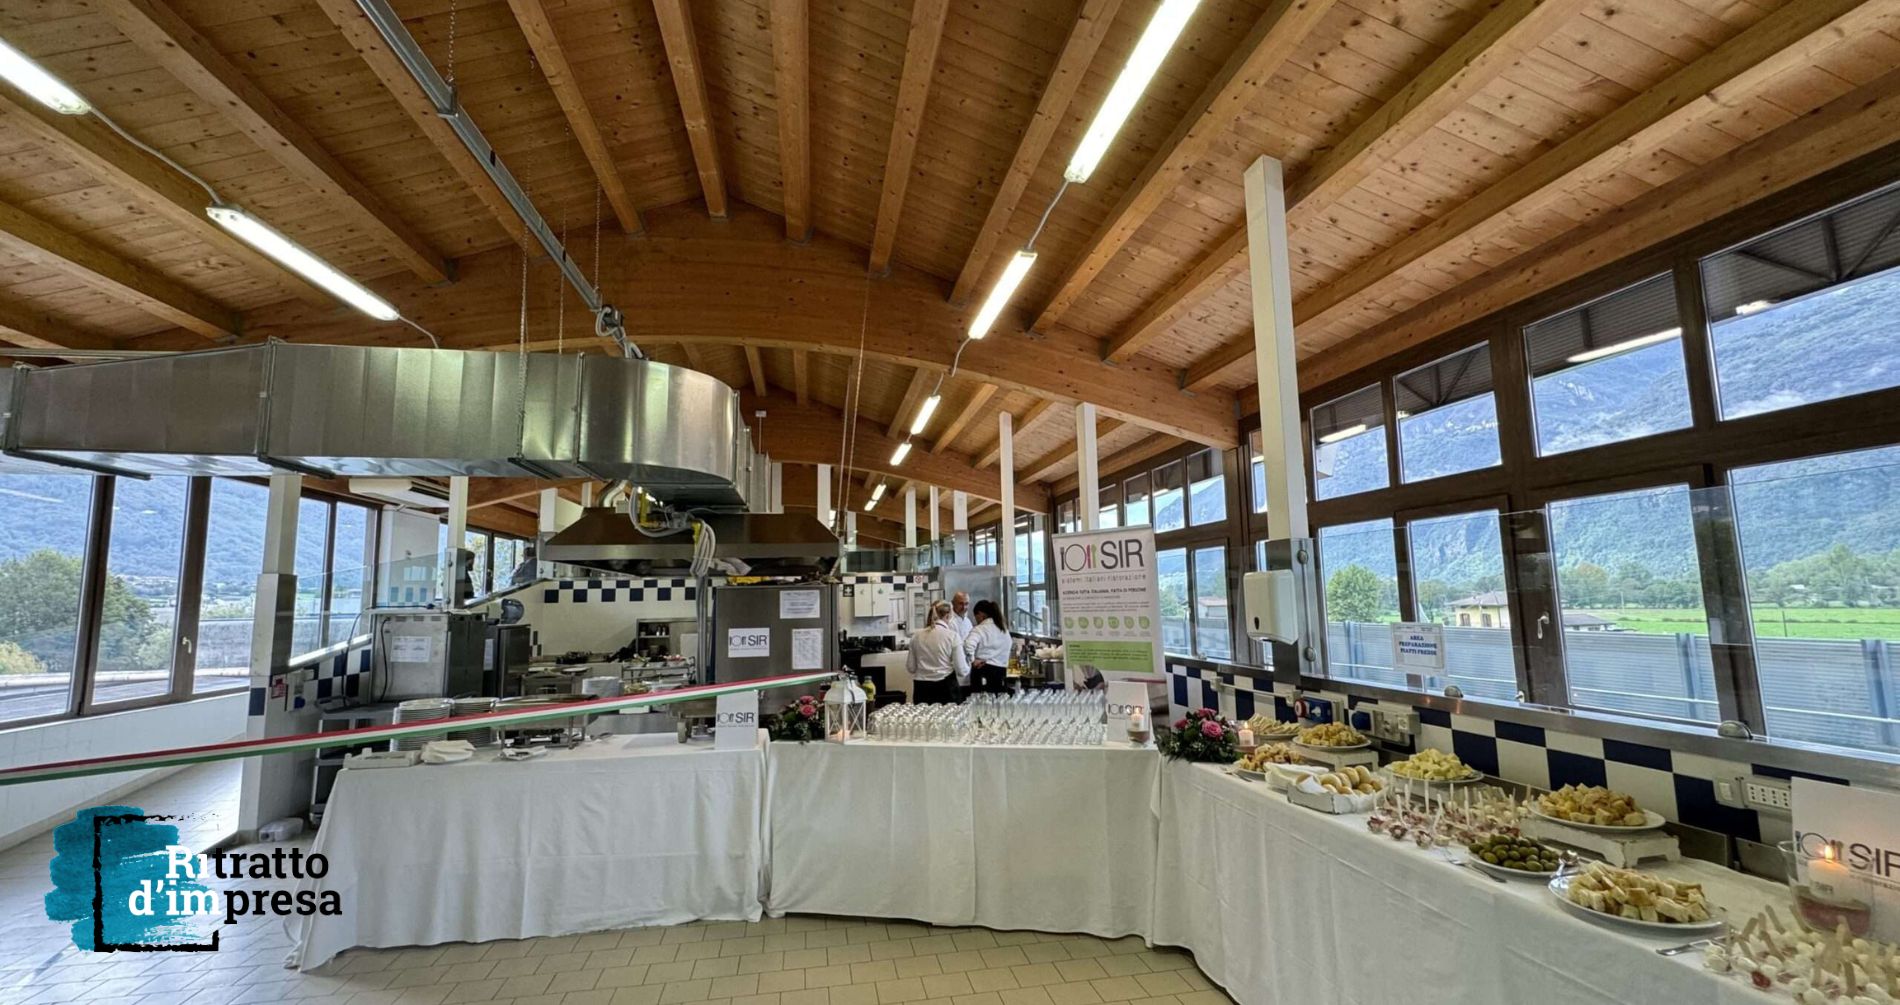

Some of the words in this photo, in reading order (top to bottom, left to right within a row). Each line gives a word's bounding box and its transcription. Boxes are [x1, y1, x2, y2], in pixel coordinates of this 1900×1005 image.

[1100, 539, 1145, 570] SIR
[747, 634, 768, 646] SIR
[1398, 641, 1437, 649] PREPARAZIONE
[735, 711, 754, 724] SIR
